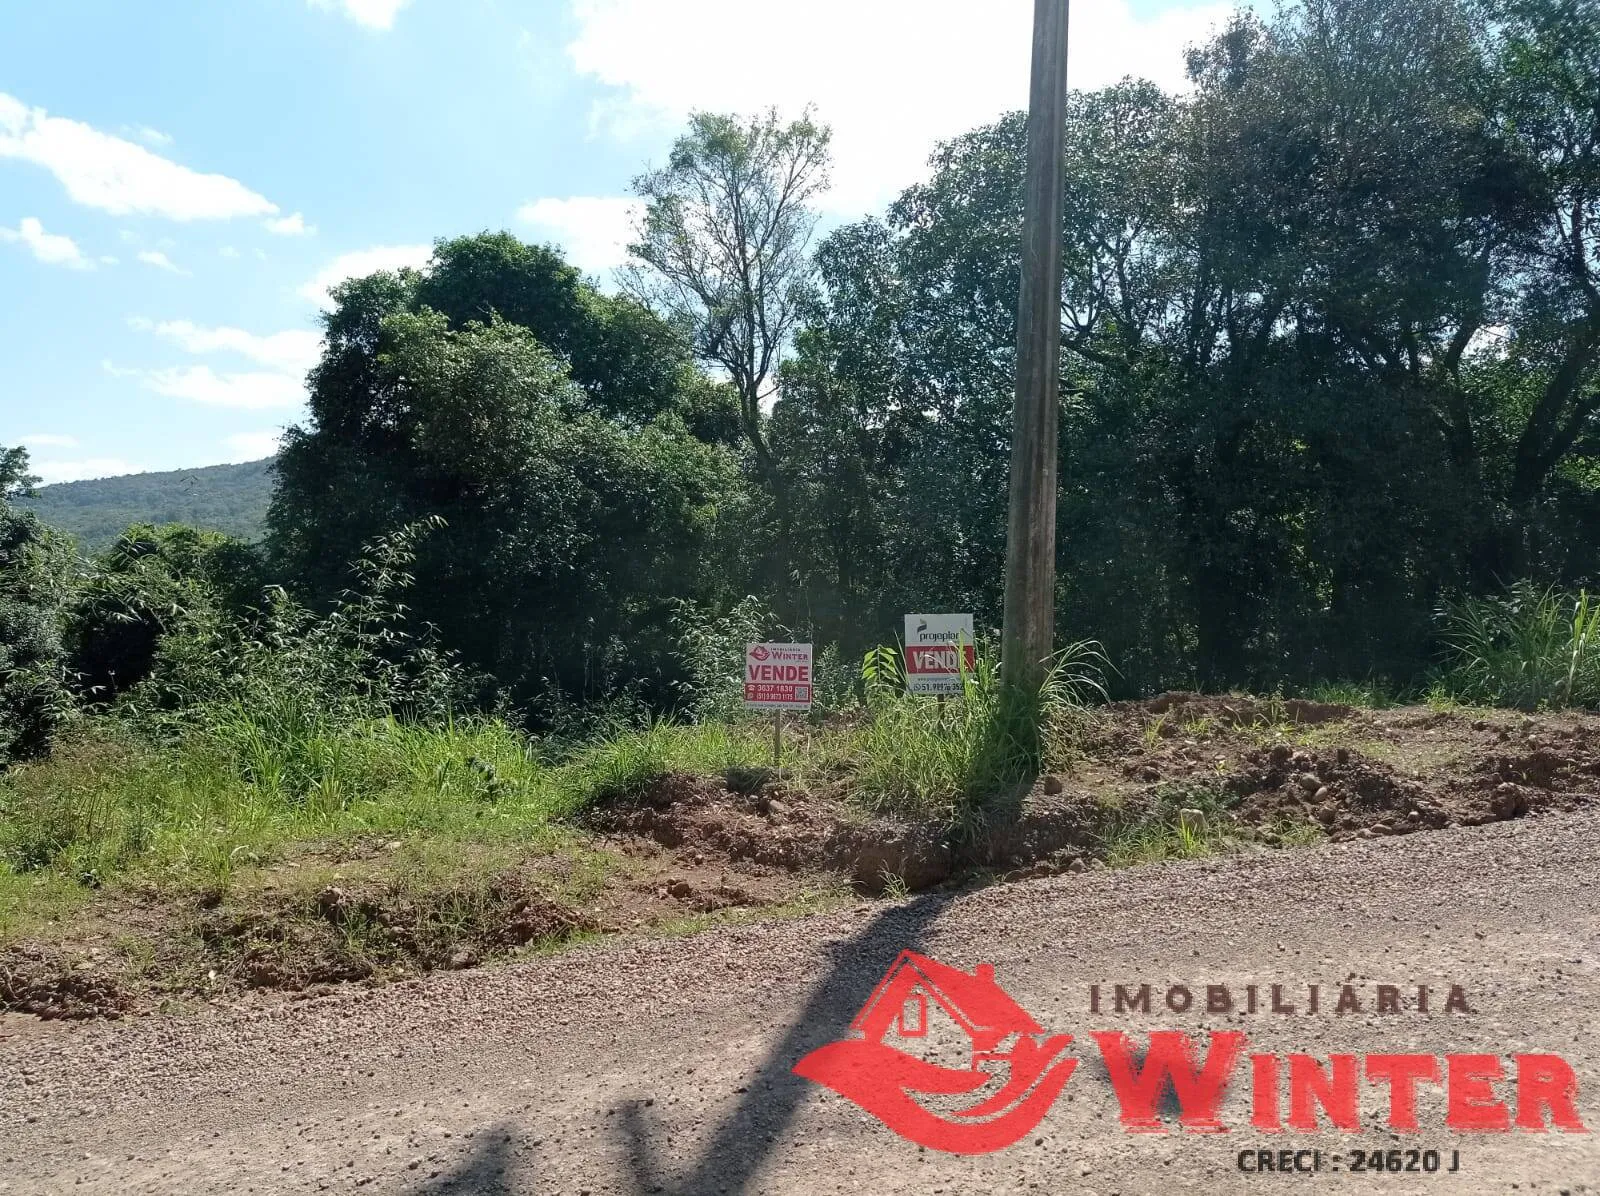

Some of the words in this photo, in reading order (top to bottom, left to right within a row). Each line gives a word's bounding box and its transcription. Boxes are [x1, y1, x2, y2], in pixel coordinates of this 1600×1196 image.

[771, 651, 808, 660] WINTER
[749, 665, 808, 681] VENDE
[757, 684, 774, 692] 3637
